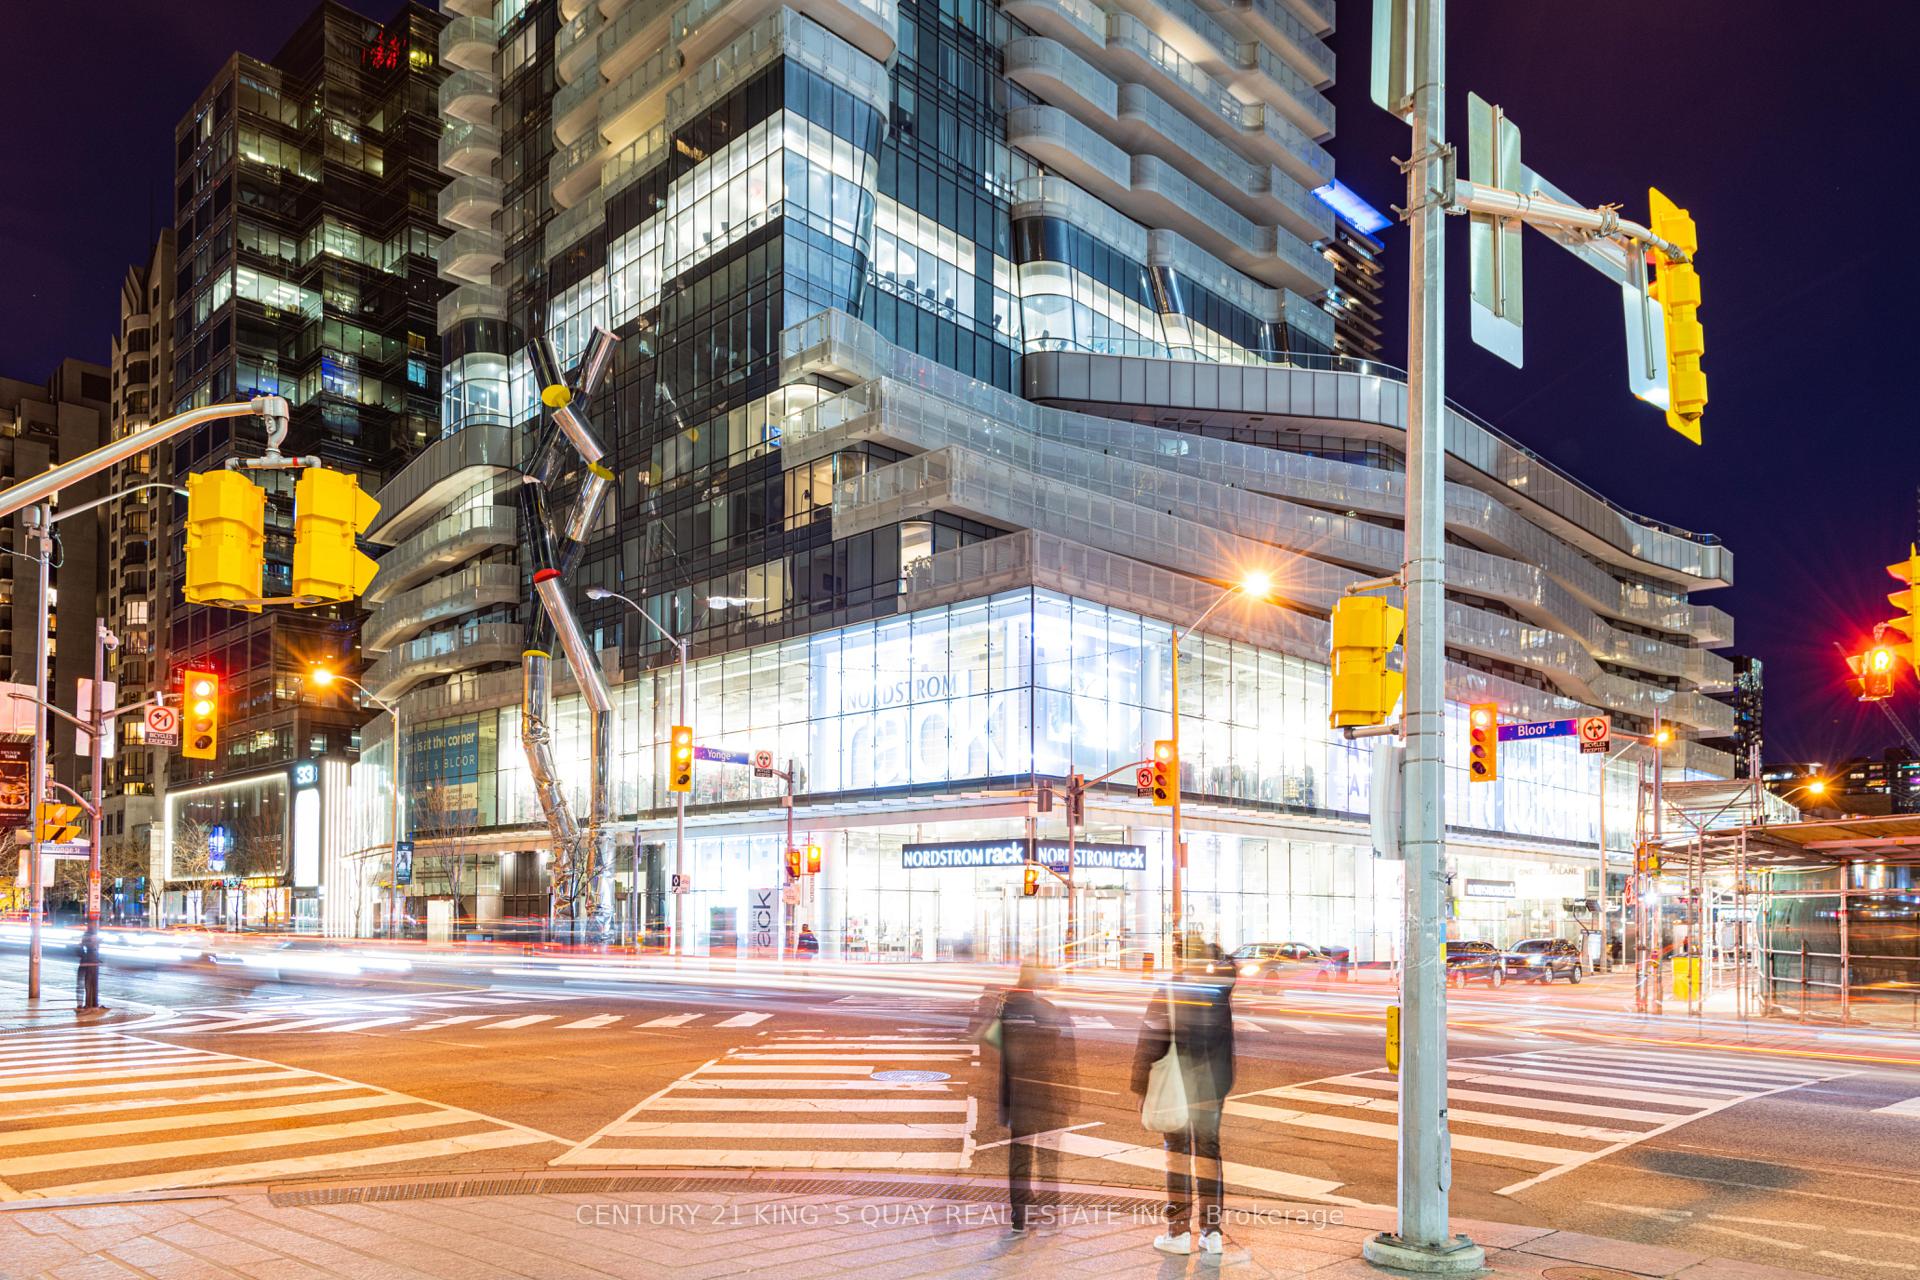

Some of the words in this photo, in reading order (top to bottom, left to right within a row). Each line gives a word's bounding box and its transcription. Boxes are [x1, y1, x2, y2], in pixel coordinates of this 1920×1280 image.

[848, 674, 957, 709] NORDSTROM
[1517, 725, 1548, 737] Bloor
[447, 732, 475, 747] corner
[1583, 741, 1606, 749] BICYCLES
[707, 748, 731, 762] Yonge
[903, 849, 984, 867] NORDSTROM
[985, 841, 1024, 865] rack
[1113, 847, 1145, 869] rack
